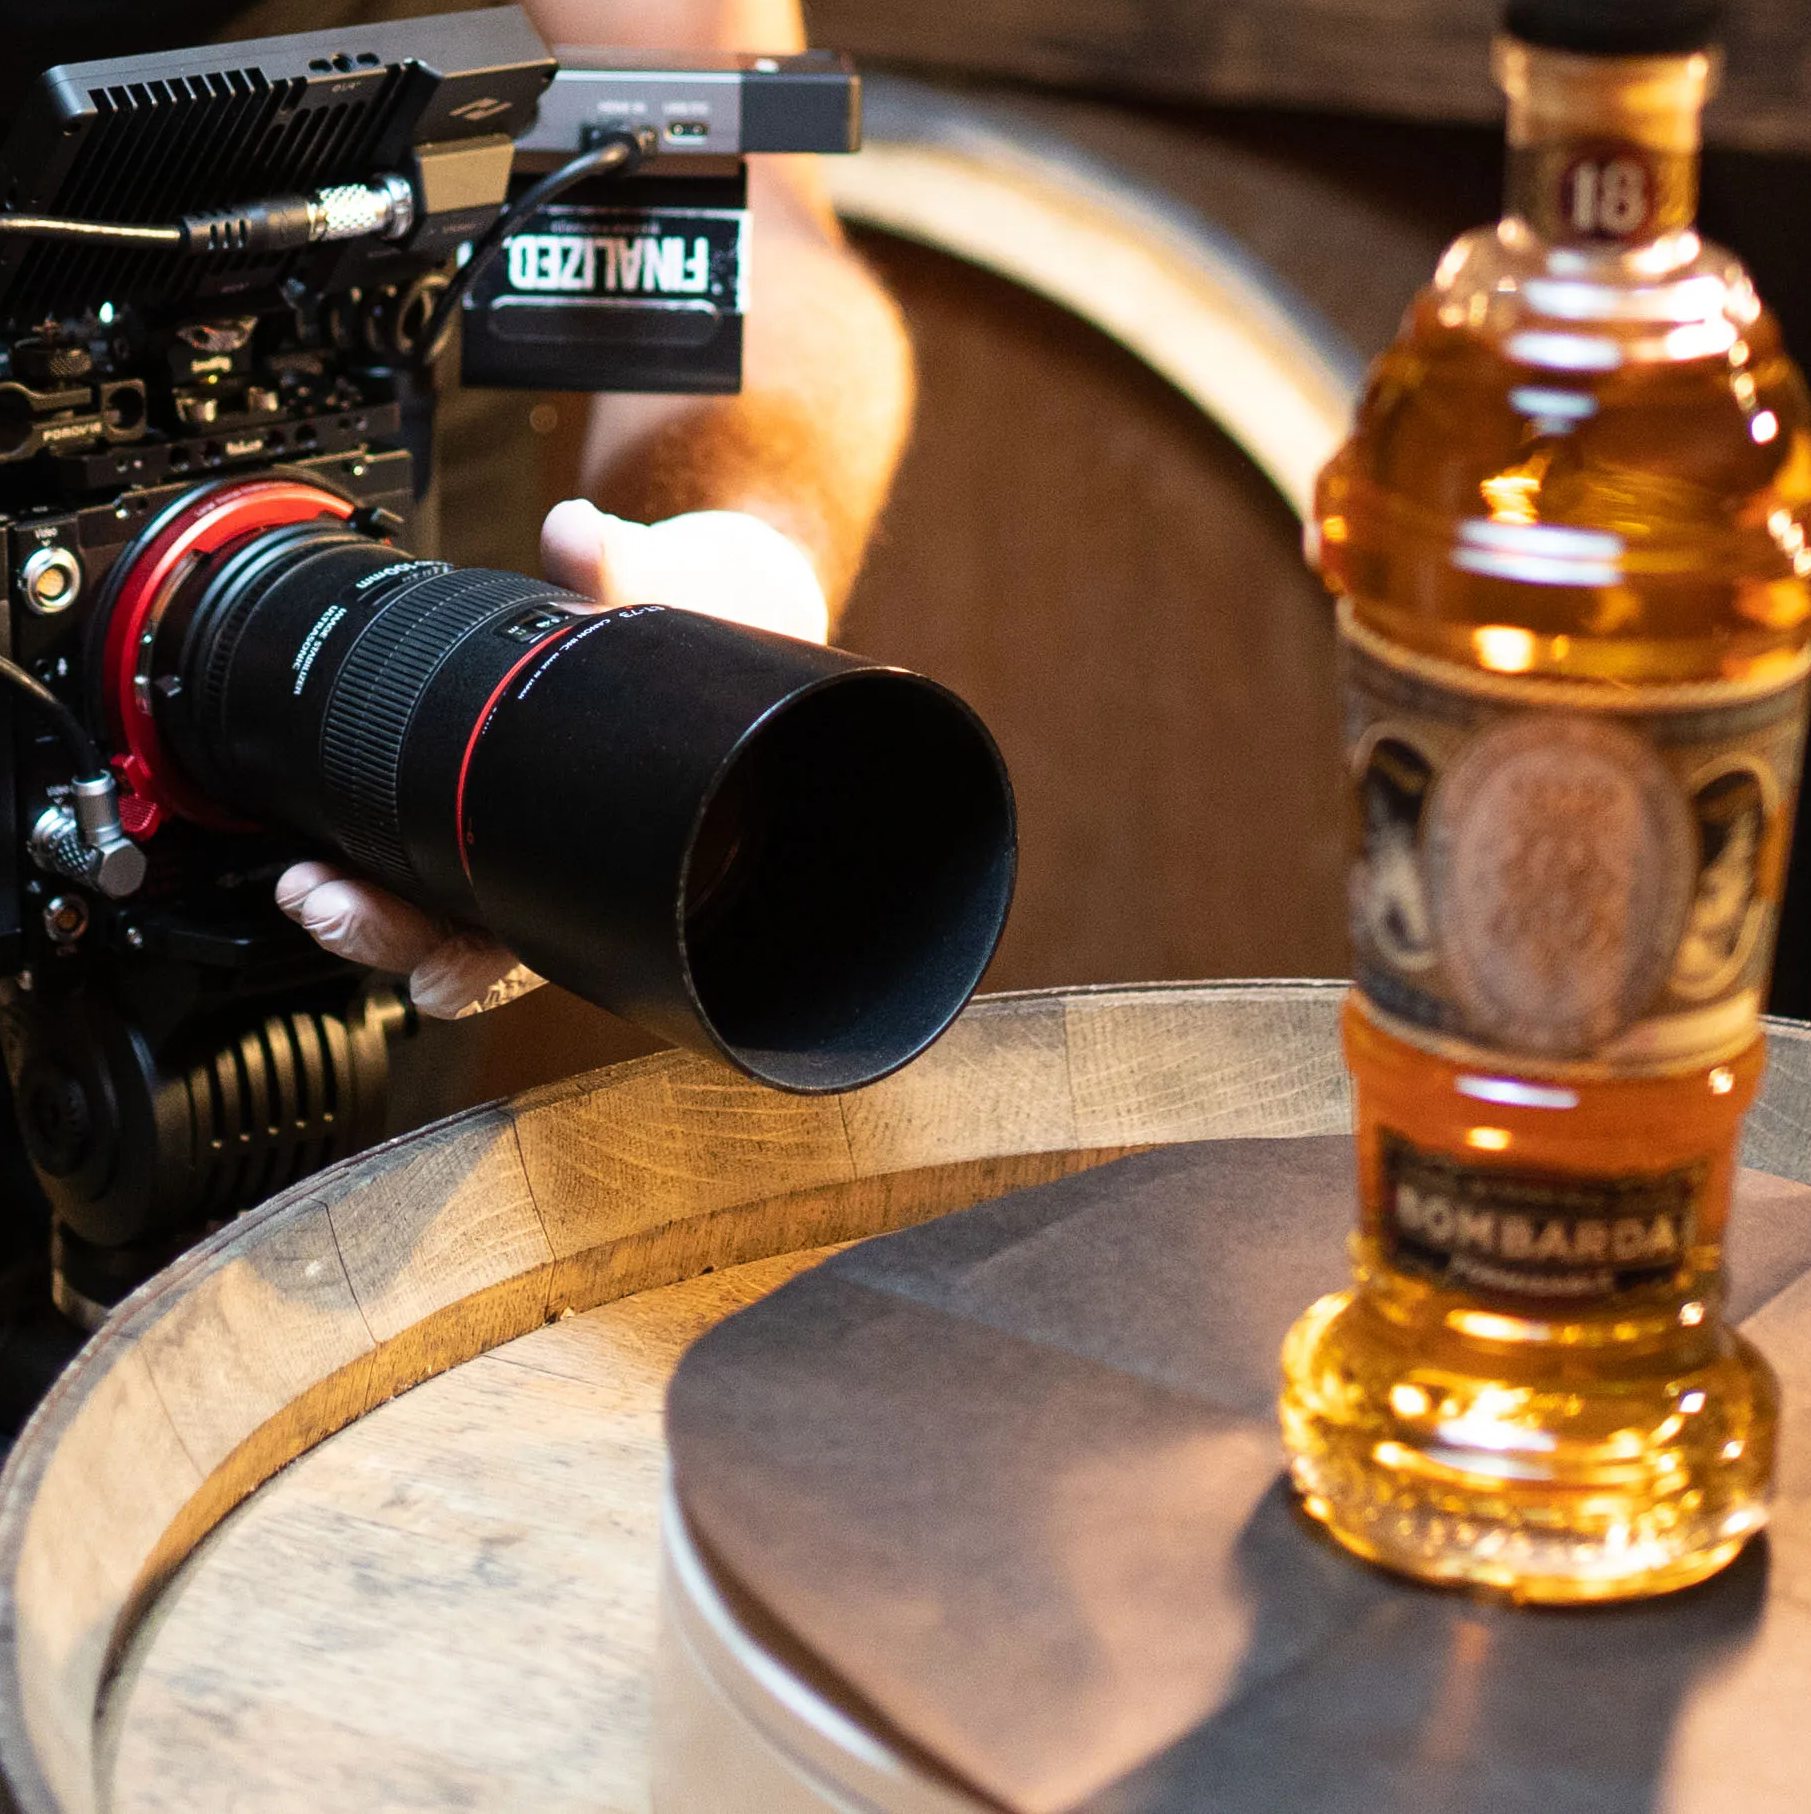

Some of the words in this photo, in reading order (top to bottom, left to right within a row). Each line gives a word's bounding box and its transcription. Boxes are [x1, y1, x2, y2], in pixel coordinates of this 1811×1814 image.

[1571, 159, 1646, 233] 18
[292, 604, 339, 672] ULTRASONIC
[319, 606, 349, 641] IMAGE
[292, 639, 324, 696] STABILIZER
